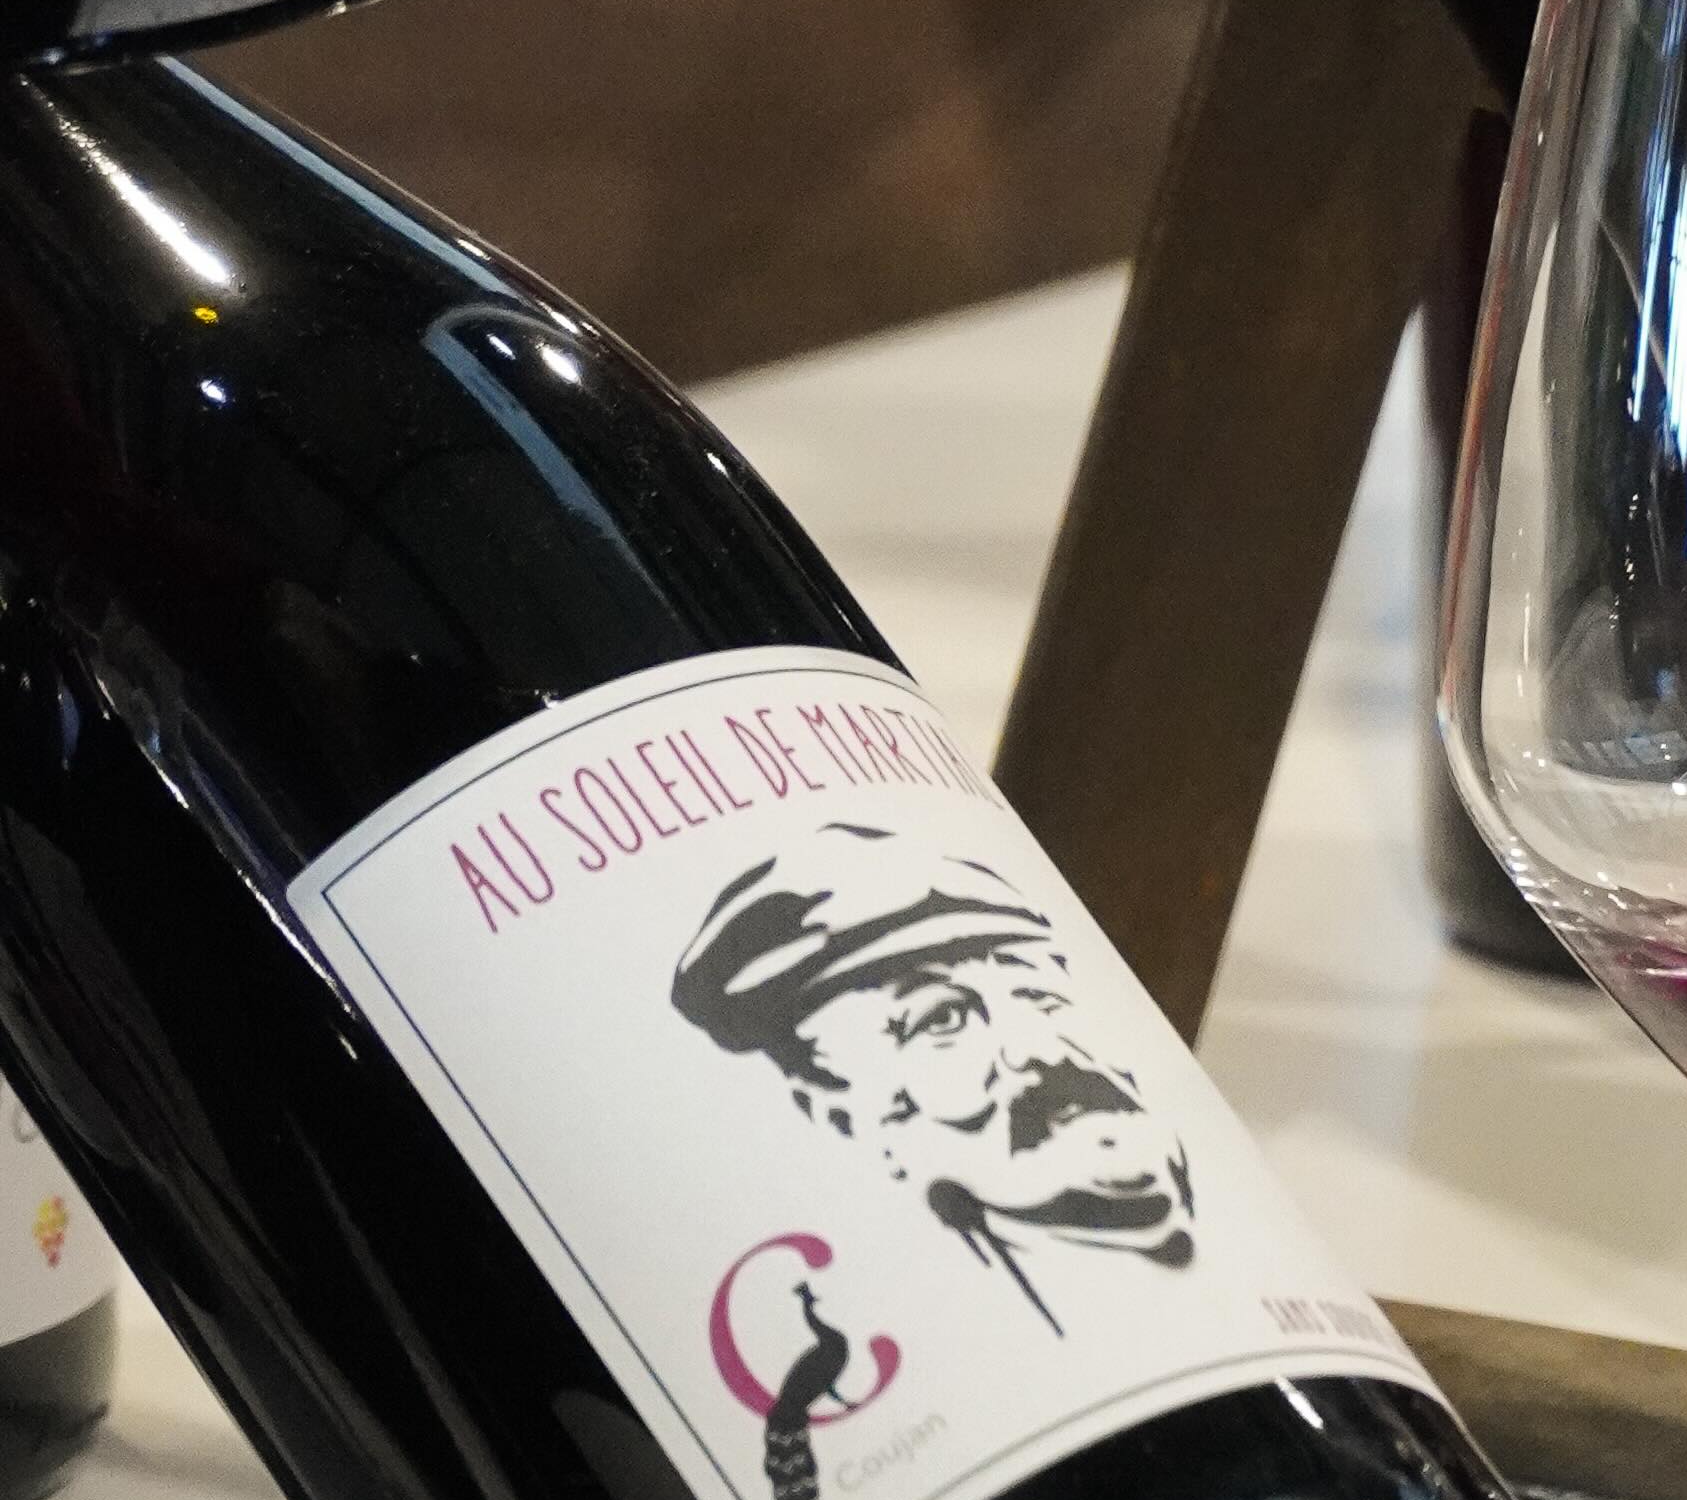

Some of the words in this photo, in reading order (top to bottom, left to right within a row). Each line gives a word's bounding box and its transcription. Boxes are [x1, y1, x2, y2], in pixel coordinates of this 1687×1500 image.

[450, 811, 555, 934] AU
[539, 729, 753, 872] SOLEIL
[724, 708, 826, 798] DE
[834, 1410, 948, 1493] Coujan
